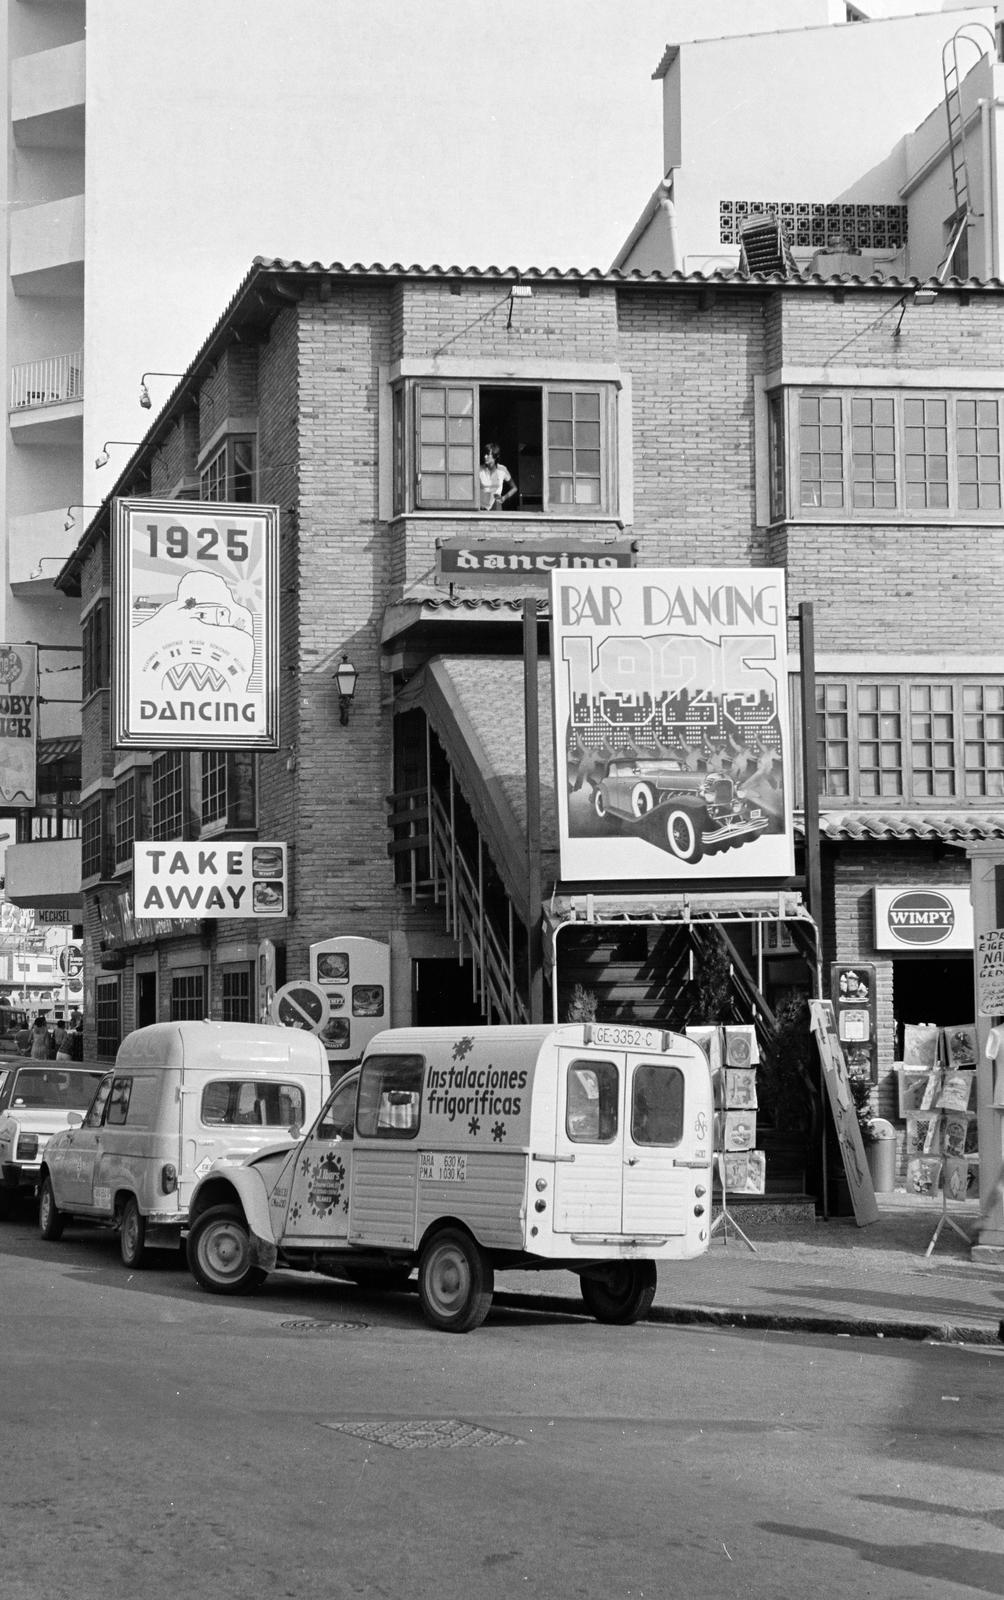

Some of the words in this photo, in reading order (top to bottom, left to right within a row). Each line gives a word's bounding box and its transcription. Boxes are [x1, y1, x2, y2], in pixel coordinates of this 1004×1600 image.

[146, 524, 249, 562] 1925
[560, 585, 623, 626] BAR
[642, 585, 778, 626] DANCING
[561, 634, 778, 726] 1925
[140, 700, 255, 722] DANCING
[145, 851, 243, 875] TAKE
[143, 885, 246, 910] AWAY
[39, 910, 70, 922] WECHSEL
[889, 911, 952, 924] WIMPY
[983, 951, 1004, 964] NA
[426, 1064, 528, 1089] Instalaciones
[420, 1154, 434, 1166] TARA
